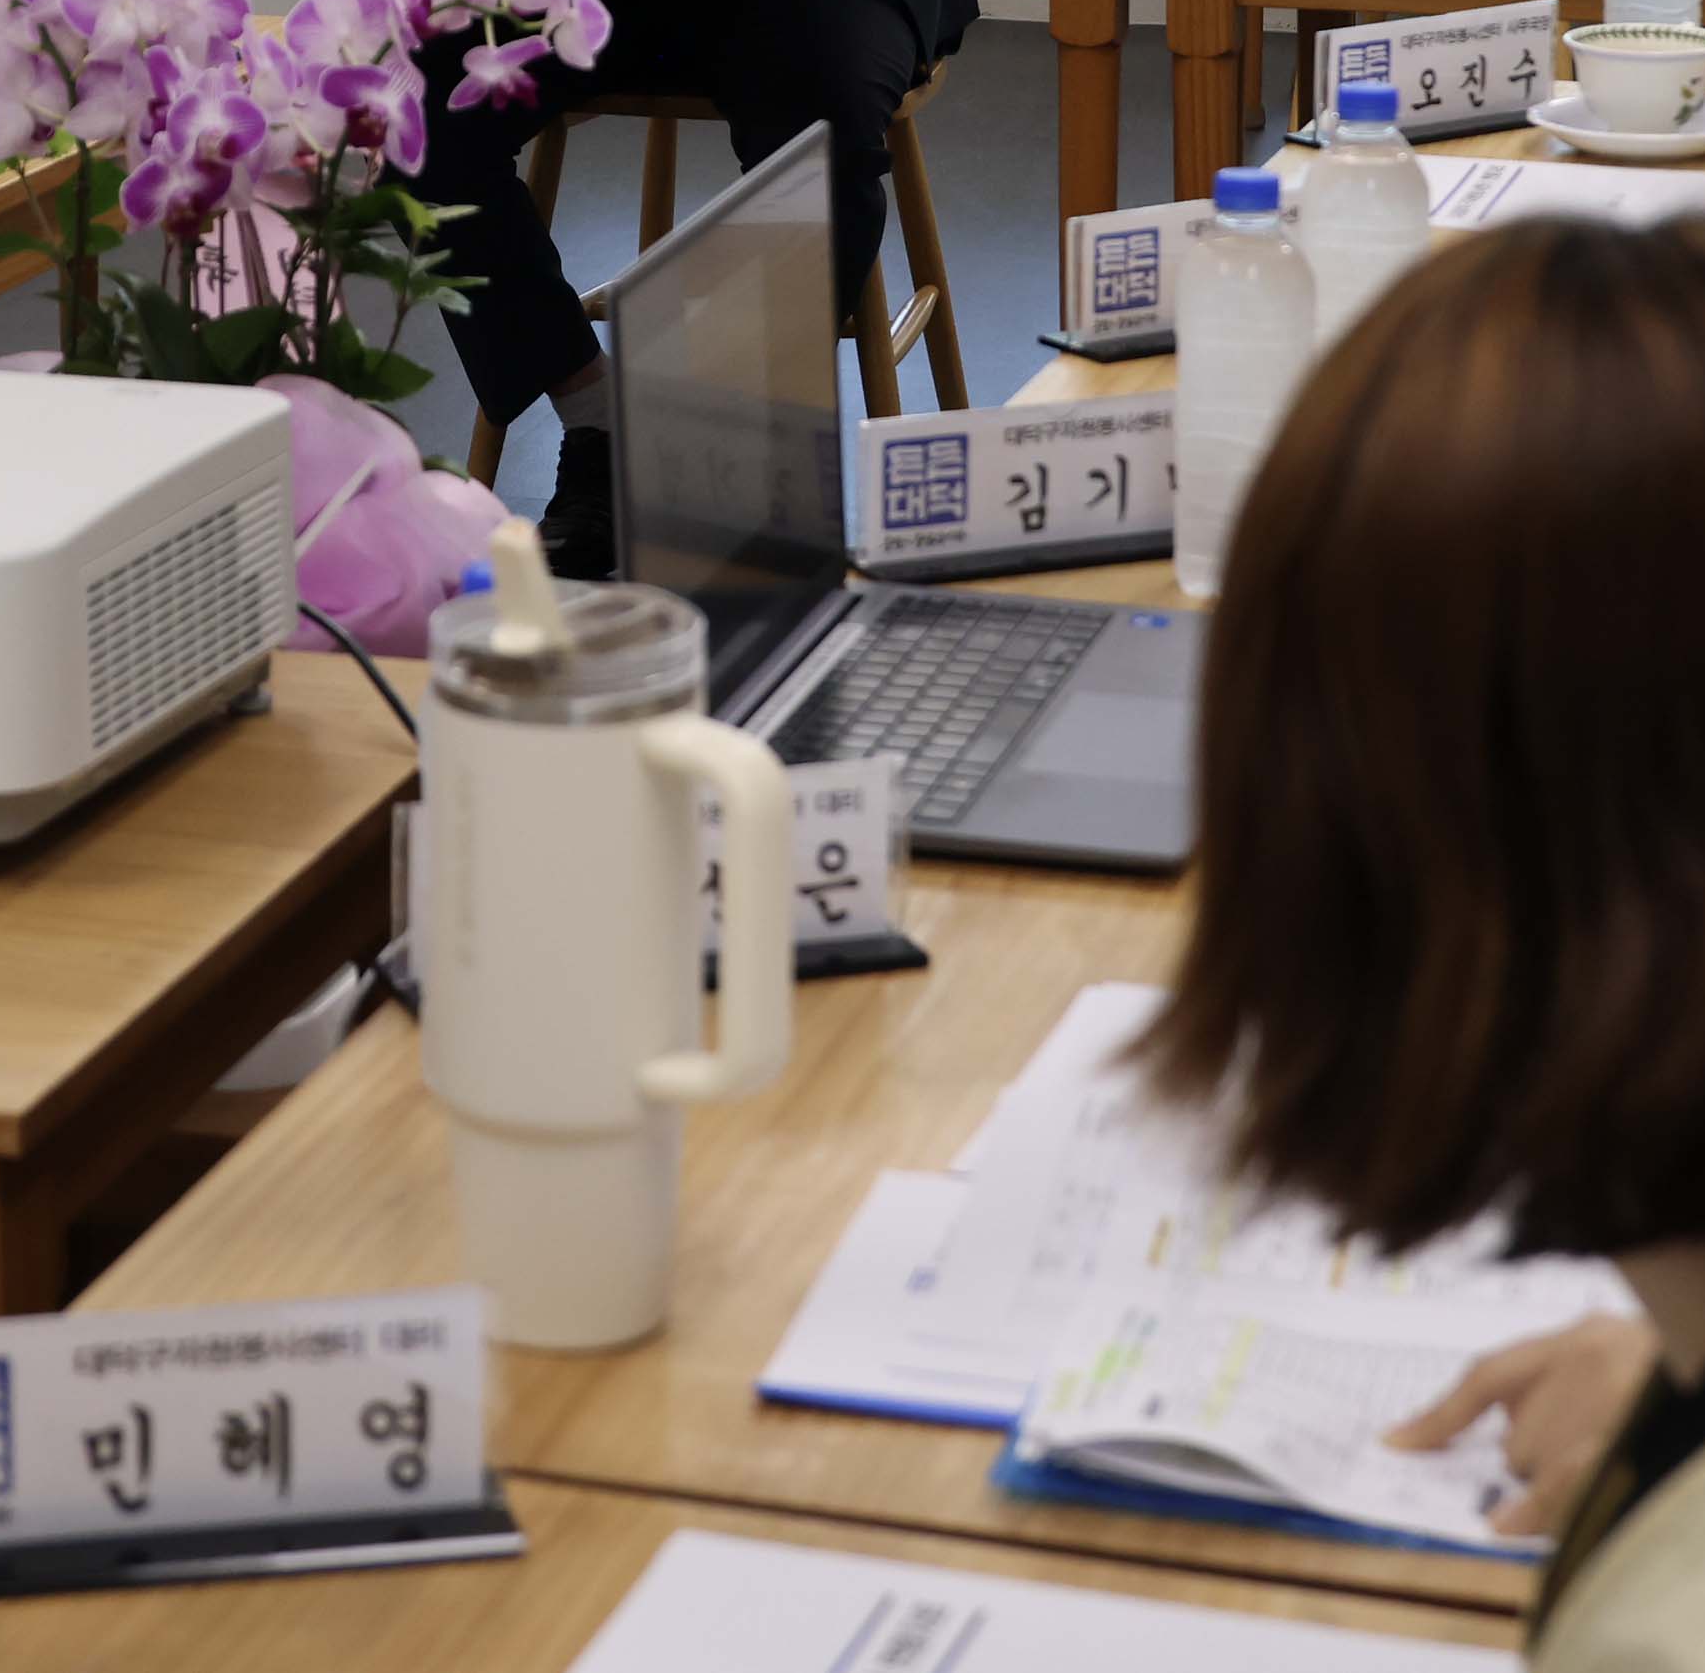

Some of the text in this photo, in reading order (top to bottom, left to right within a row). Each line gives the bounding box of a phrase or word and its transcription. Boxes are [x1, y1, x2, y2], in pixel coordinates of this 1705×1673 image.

[1412, 48, 1539, 111] 오진수
[1005, 453, 1177, 534] 김기
[82, 1381, 430, 1515] 민혜영
